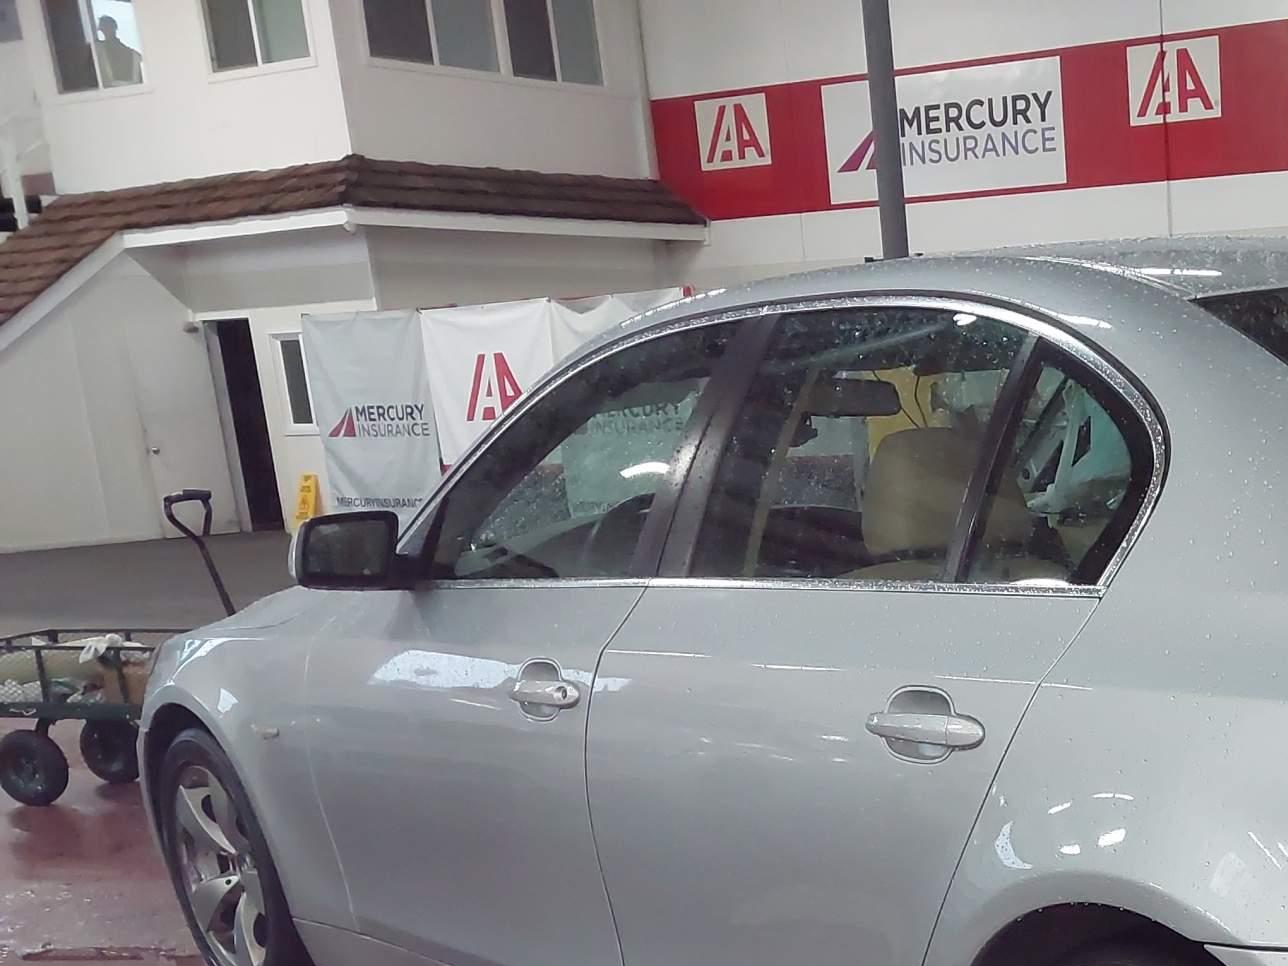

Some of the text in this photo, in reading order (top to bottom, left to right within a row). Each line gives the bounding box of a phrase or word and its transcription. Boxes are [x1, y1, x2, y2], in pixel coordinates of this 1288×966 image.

[899, 90, 1053, 138] MERCURY
[901, 126, 1057, 167] INSURANCE
[354, 404, 424, 422] MERCURY
[357, 422, 431, 438] INSURANCE
